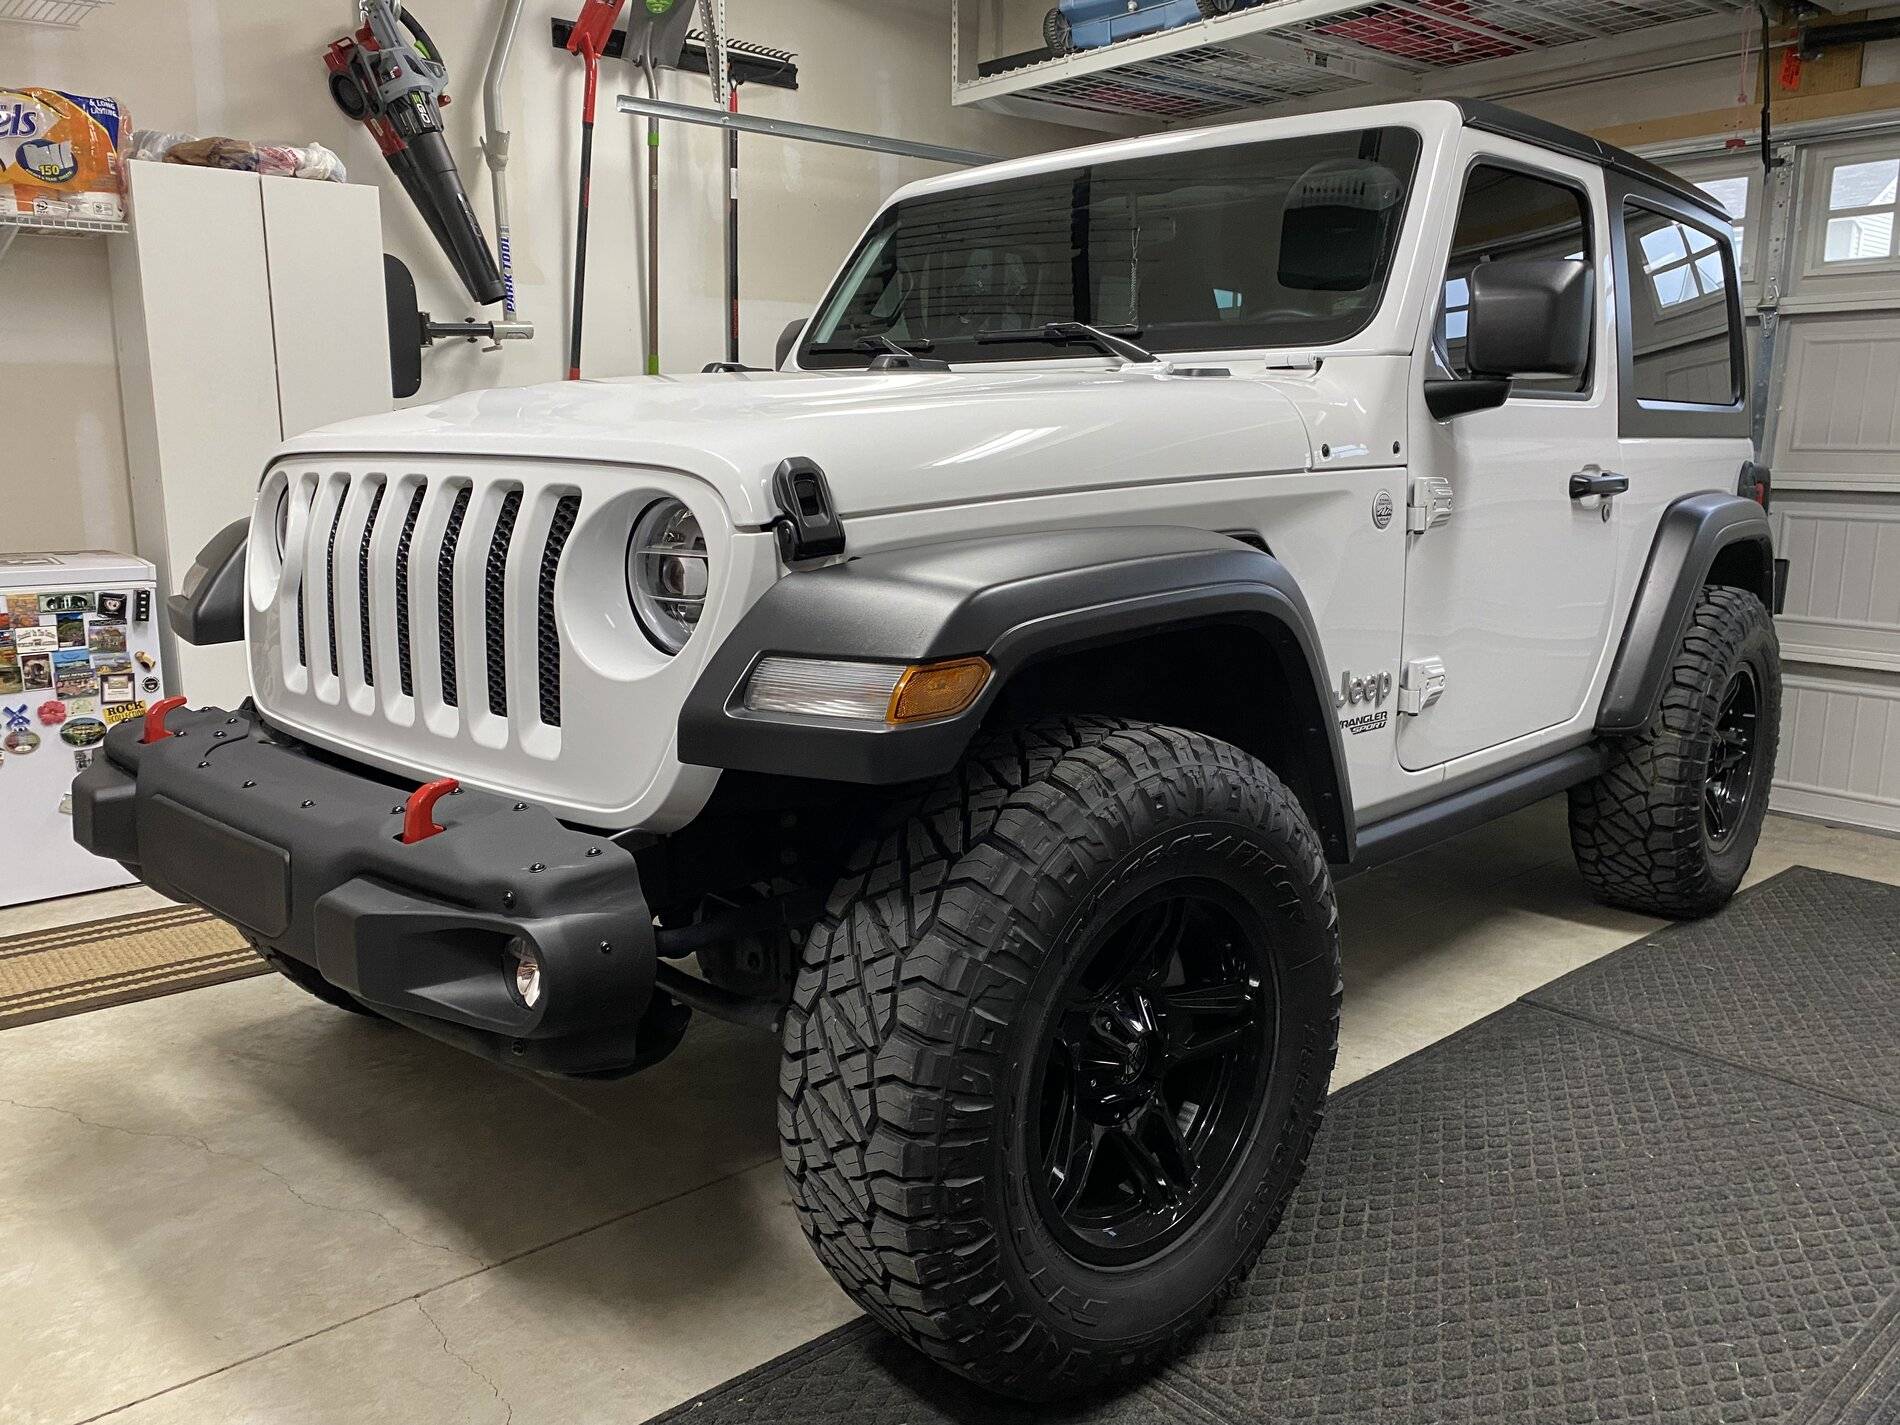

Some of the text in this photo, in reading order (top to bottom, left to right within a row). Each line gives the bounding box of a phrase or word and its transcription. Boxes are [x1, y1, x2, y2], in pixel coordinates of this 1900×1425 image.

[411, 93, 431, 124] EGO
[39, 165, 60, 176] 150
[500, 237, 515, 312] PARK TOOL
[1333, 670, 1392, 708] Jeep
[107, 700, 144, 716] ROCK
[1340, 711, 1387, 728] RANGLER
